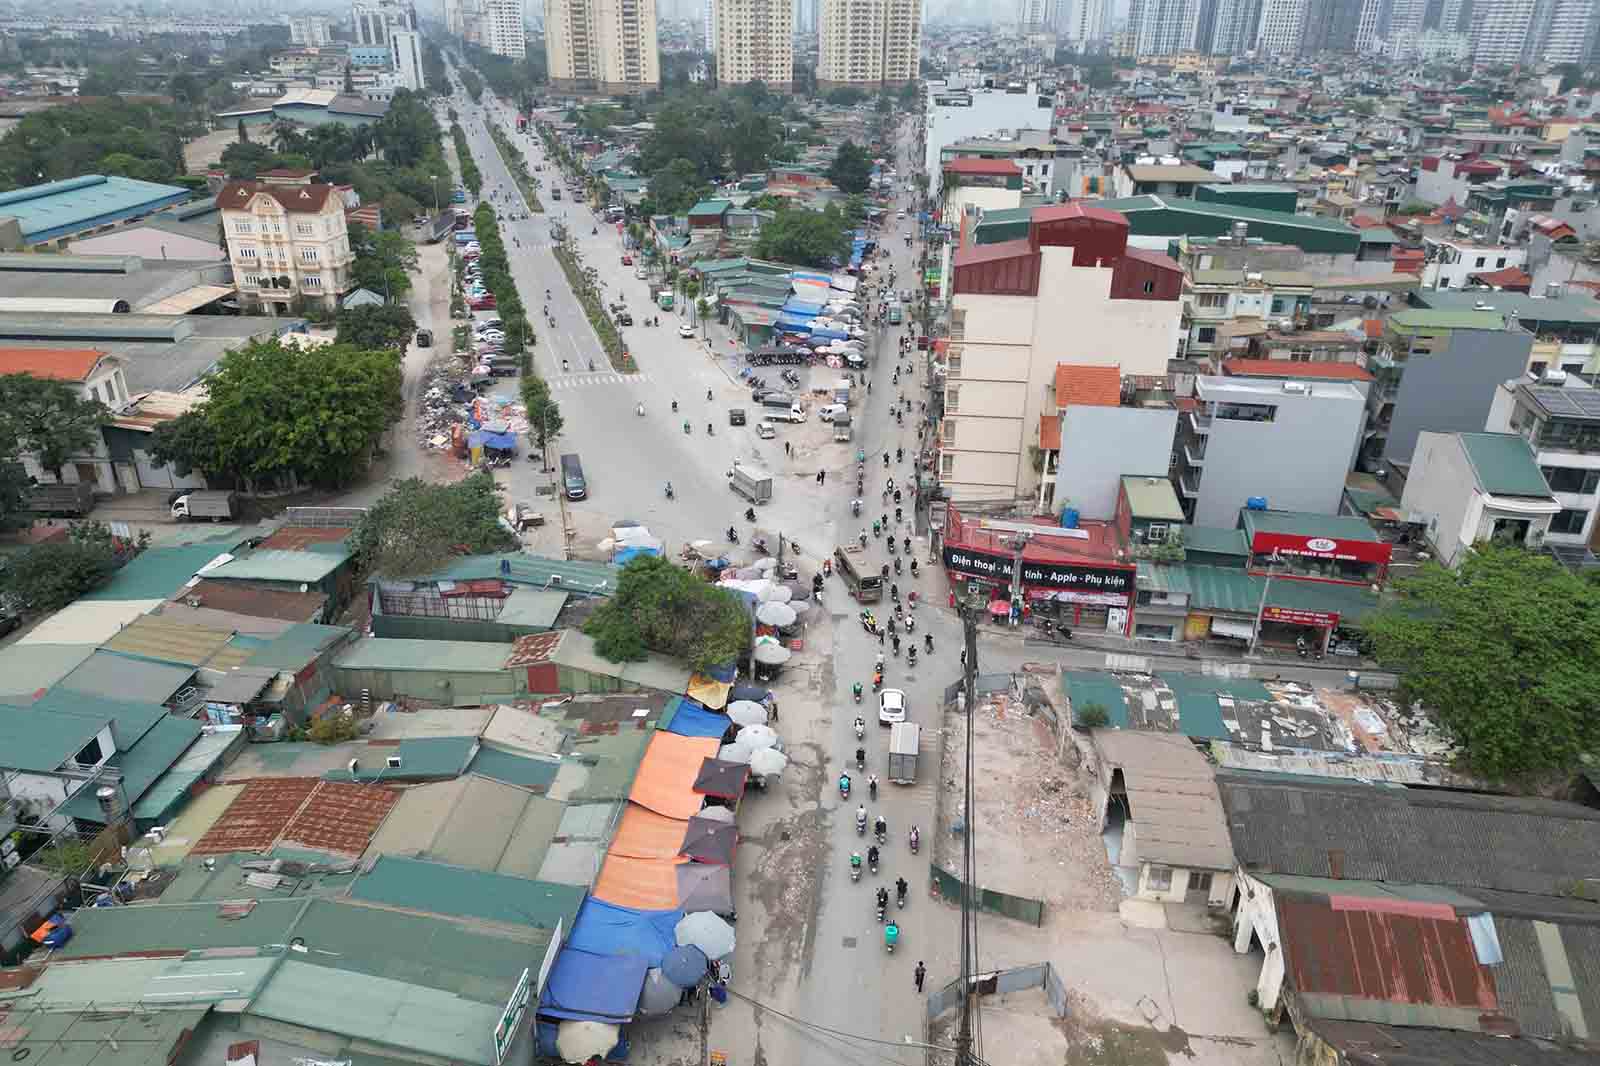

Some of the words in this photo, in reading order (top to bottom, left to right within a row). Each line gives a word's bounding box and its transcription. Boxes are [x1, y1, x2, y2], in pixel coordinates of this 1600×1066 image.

[952, 554, 971, 567] Điện
[974, 559, 996, 573] thoại
[1024, 569, 1042, 580] tính
[1050, 571, 1078, 584] Apple
[1085, 574, 1102, 587] Phụ
[1105, 575, 1125, 587] kiện
